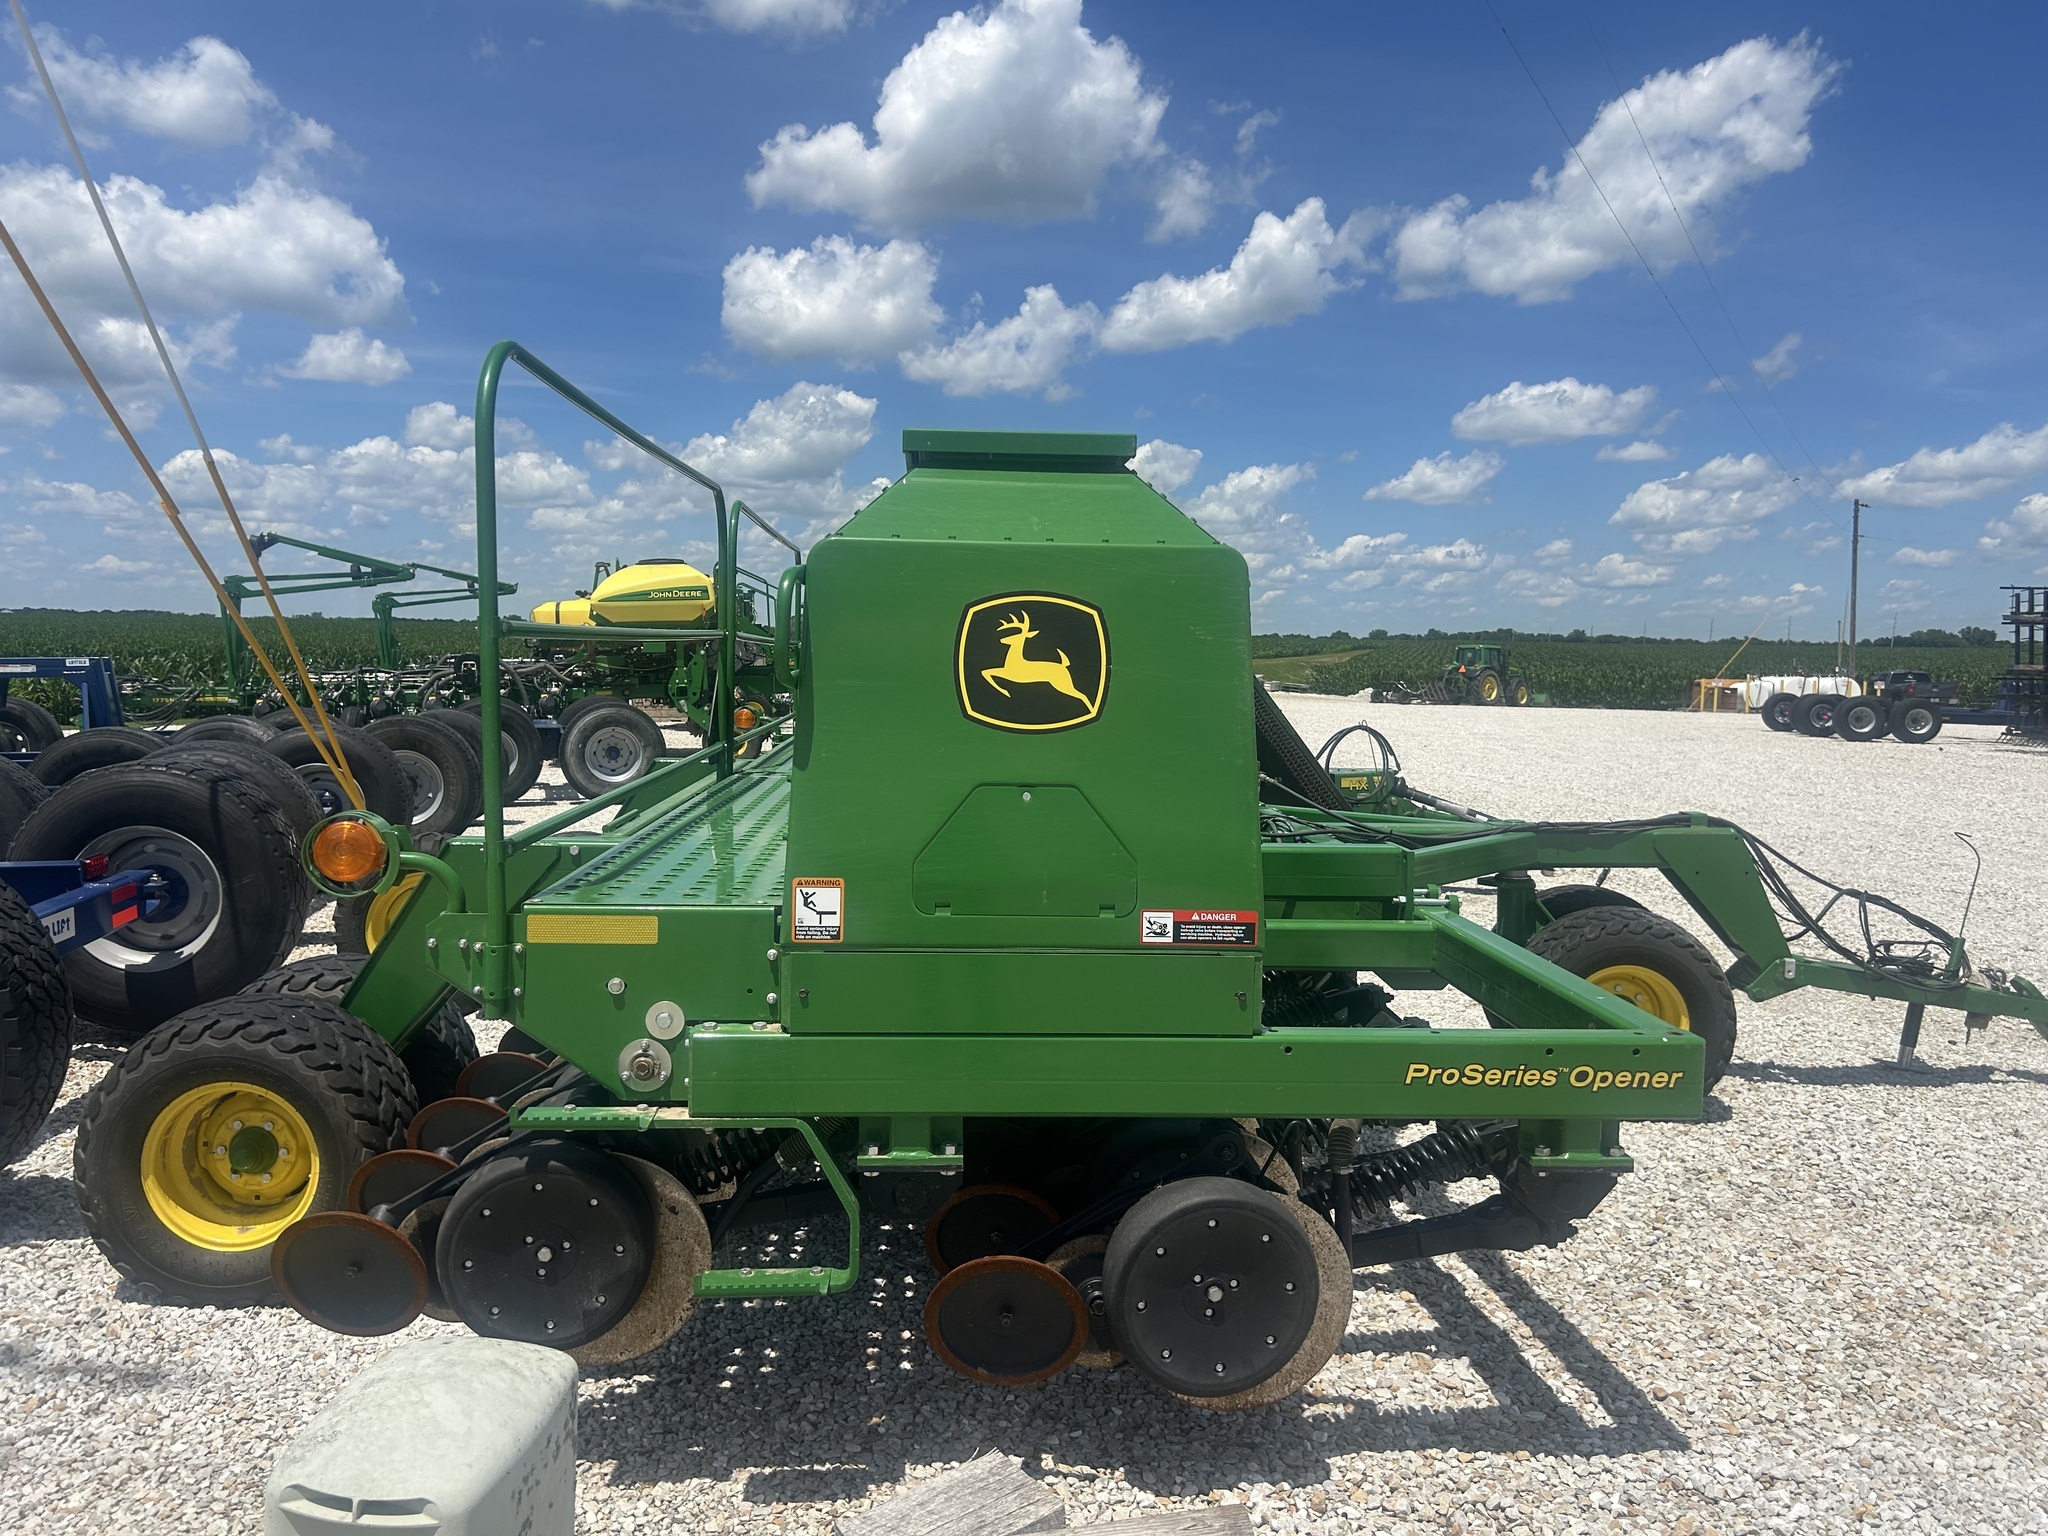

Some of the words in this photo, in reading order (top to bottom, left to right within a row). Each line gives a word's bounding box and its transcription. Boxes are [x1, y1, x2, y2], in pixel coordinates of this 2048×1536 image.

[648, 591, 672, 599] JOHN
[673, 590, 702, 598] DEERE
[1200, 913, 1237, 921] DANGER
[1569, 1065, 1684, 1092] Opener
